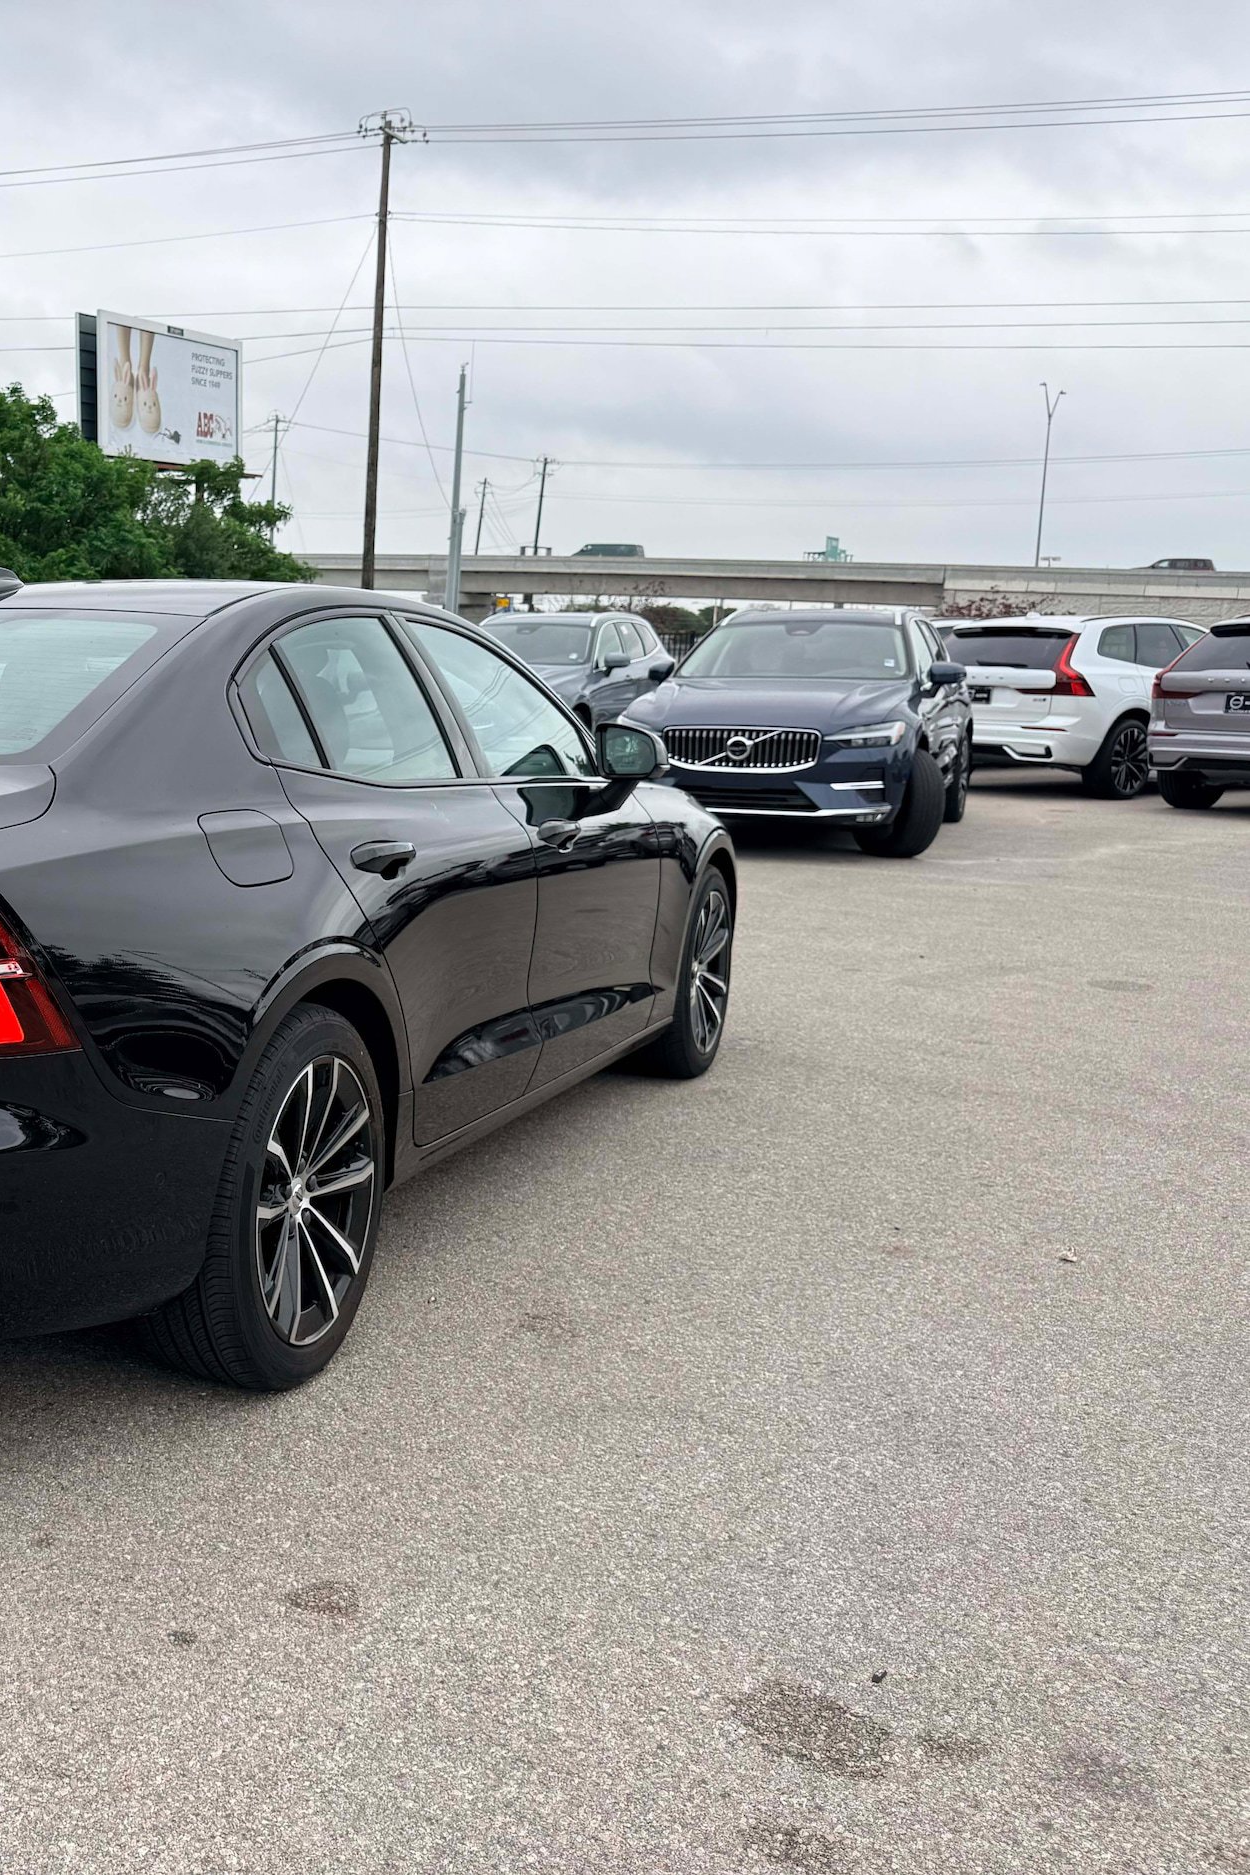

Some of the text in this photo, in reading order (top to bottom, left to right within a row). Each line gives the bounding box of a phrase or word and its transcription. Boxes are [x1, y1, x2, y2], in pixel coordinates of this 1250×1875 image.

[191, 352, 225, 367] PROTECTING
[191, 364, 233, 380] FUZZY SLIPPERS
[191, 376, 207, 388] SINCE
[196, 411, 214, 439] ABC
